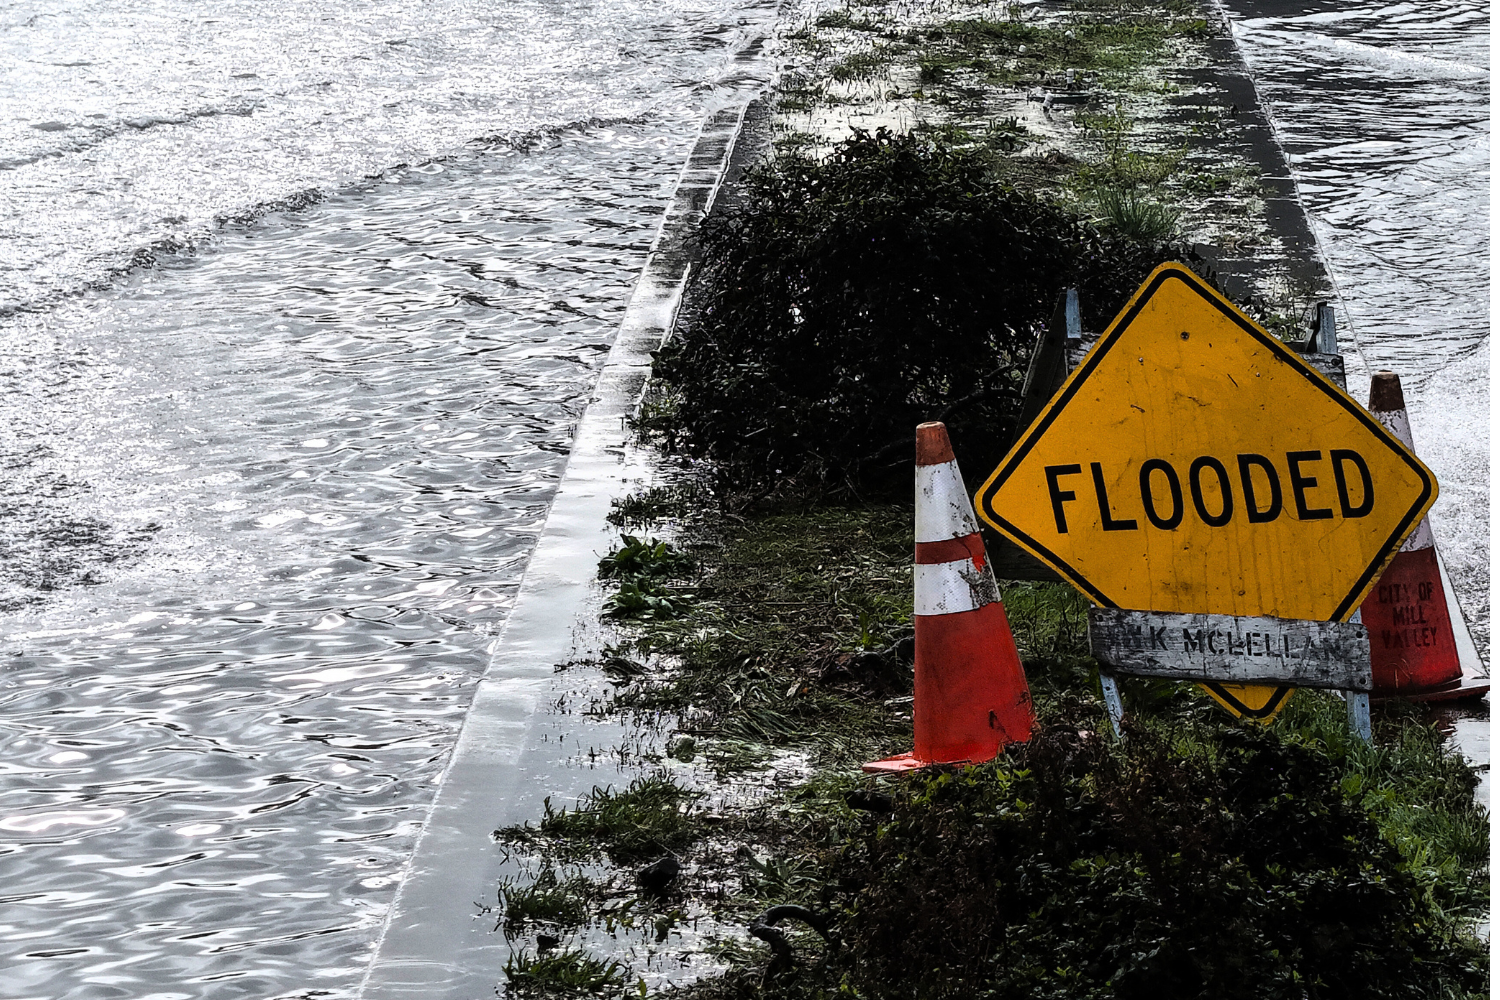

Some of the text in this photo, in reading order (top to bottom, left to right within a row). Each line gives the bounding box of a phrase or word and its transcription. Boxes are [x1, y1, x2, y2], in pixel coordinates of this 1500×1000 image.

[1044, 449, 1375, 534] FLOODED
[1418, 582, 1433, 600] OF
[1393, 605, 1427, 626] MILL
[1381, 626, 1437, 649] VALLEY
